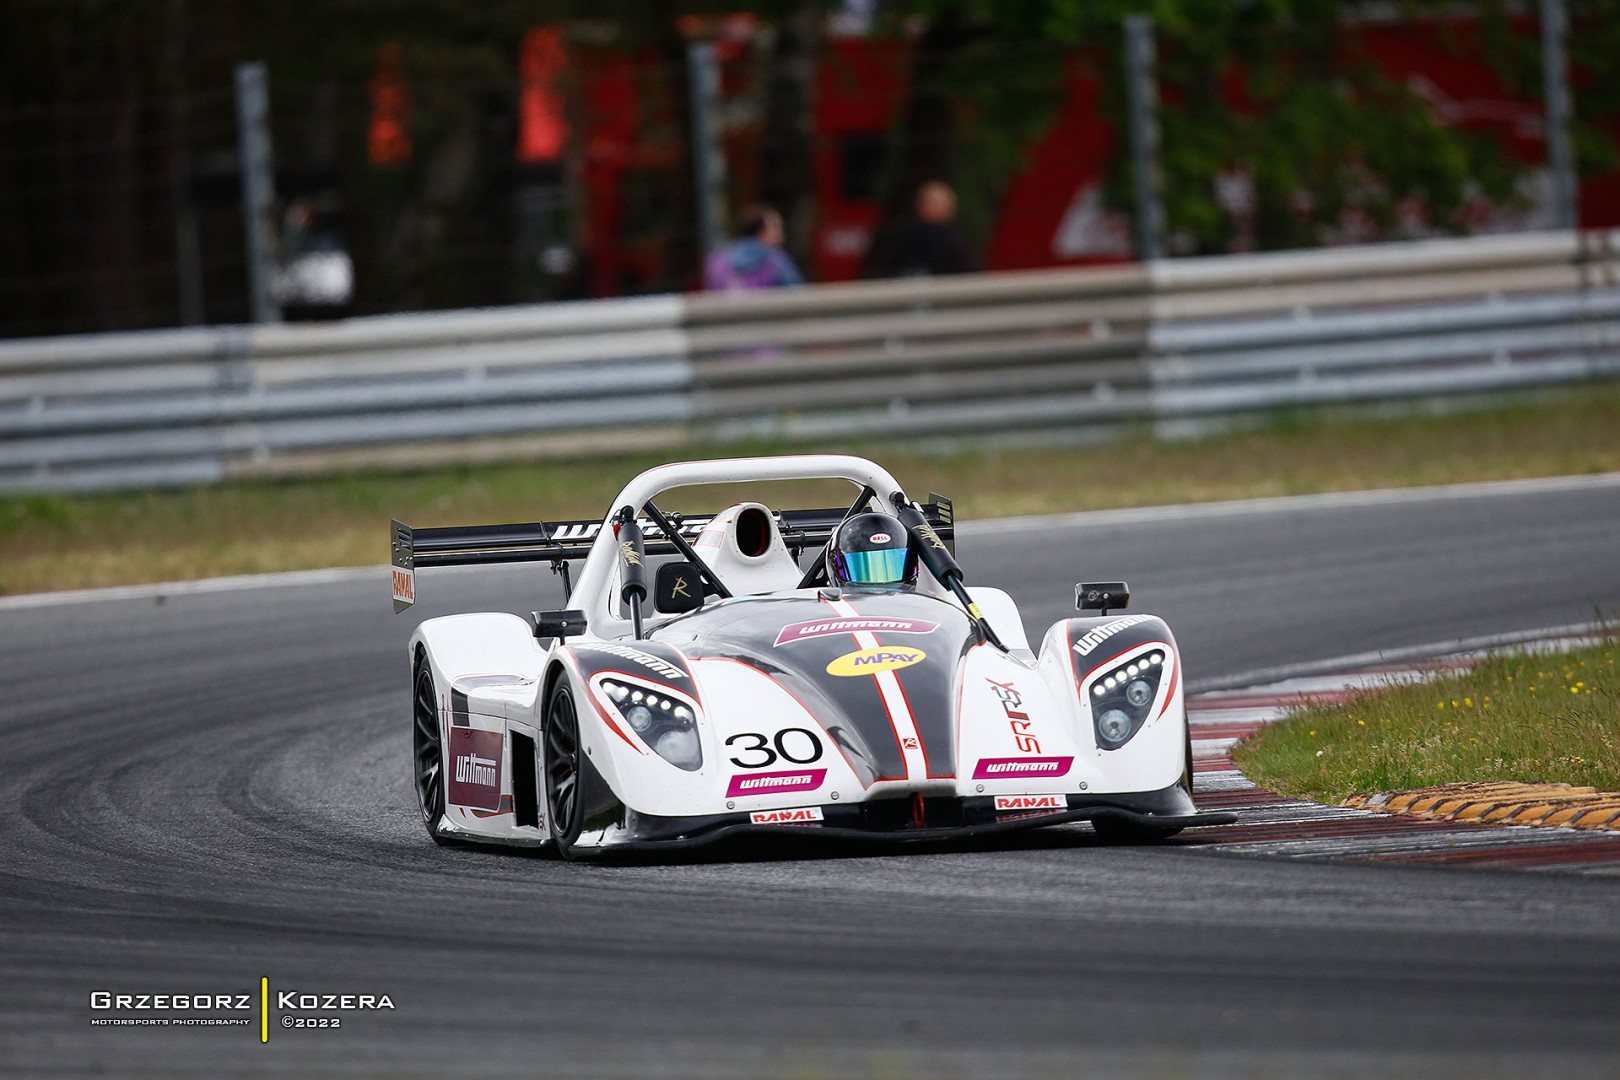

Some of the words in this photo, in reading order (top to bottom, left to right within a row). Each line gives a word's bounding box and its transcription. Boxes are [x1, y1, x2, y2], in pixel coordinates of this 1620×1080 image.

[799, 621, 912, 634] wittmann
[1072, 614, 1153, 656] wittmann
[725, 728, 823, 769] 30
[456, 752, 496, 787] wittmann
[986, 762, 1059, 773] wittmann
[740, 775, 812, 789] wittmann
[997, 797, 1060, 808] RANAL
[753, 810, 816, 822] RANAL
